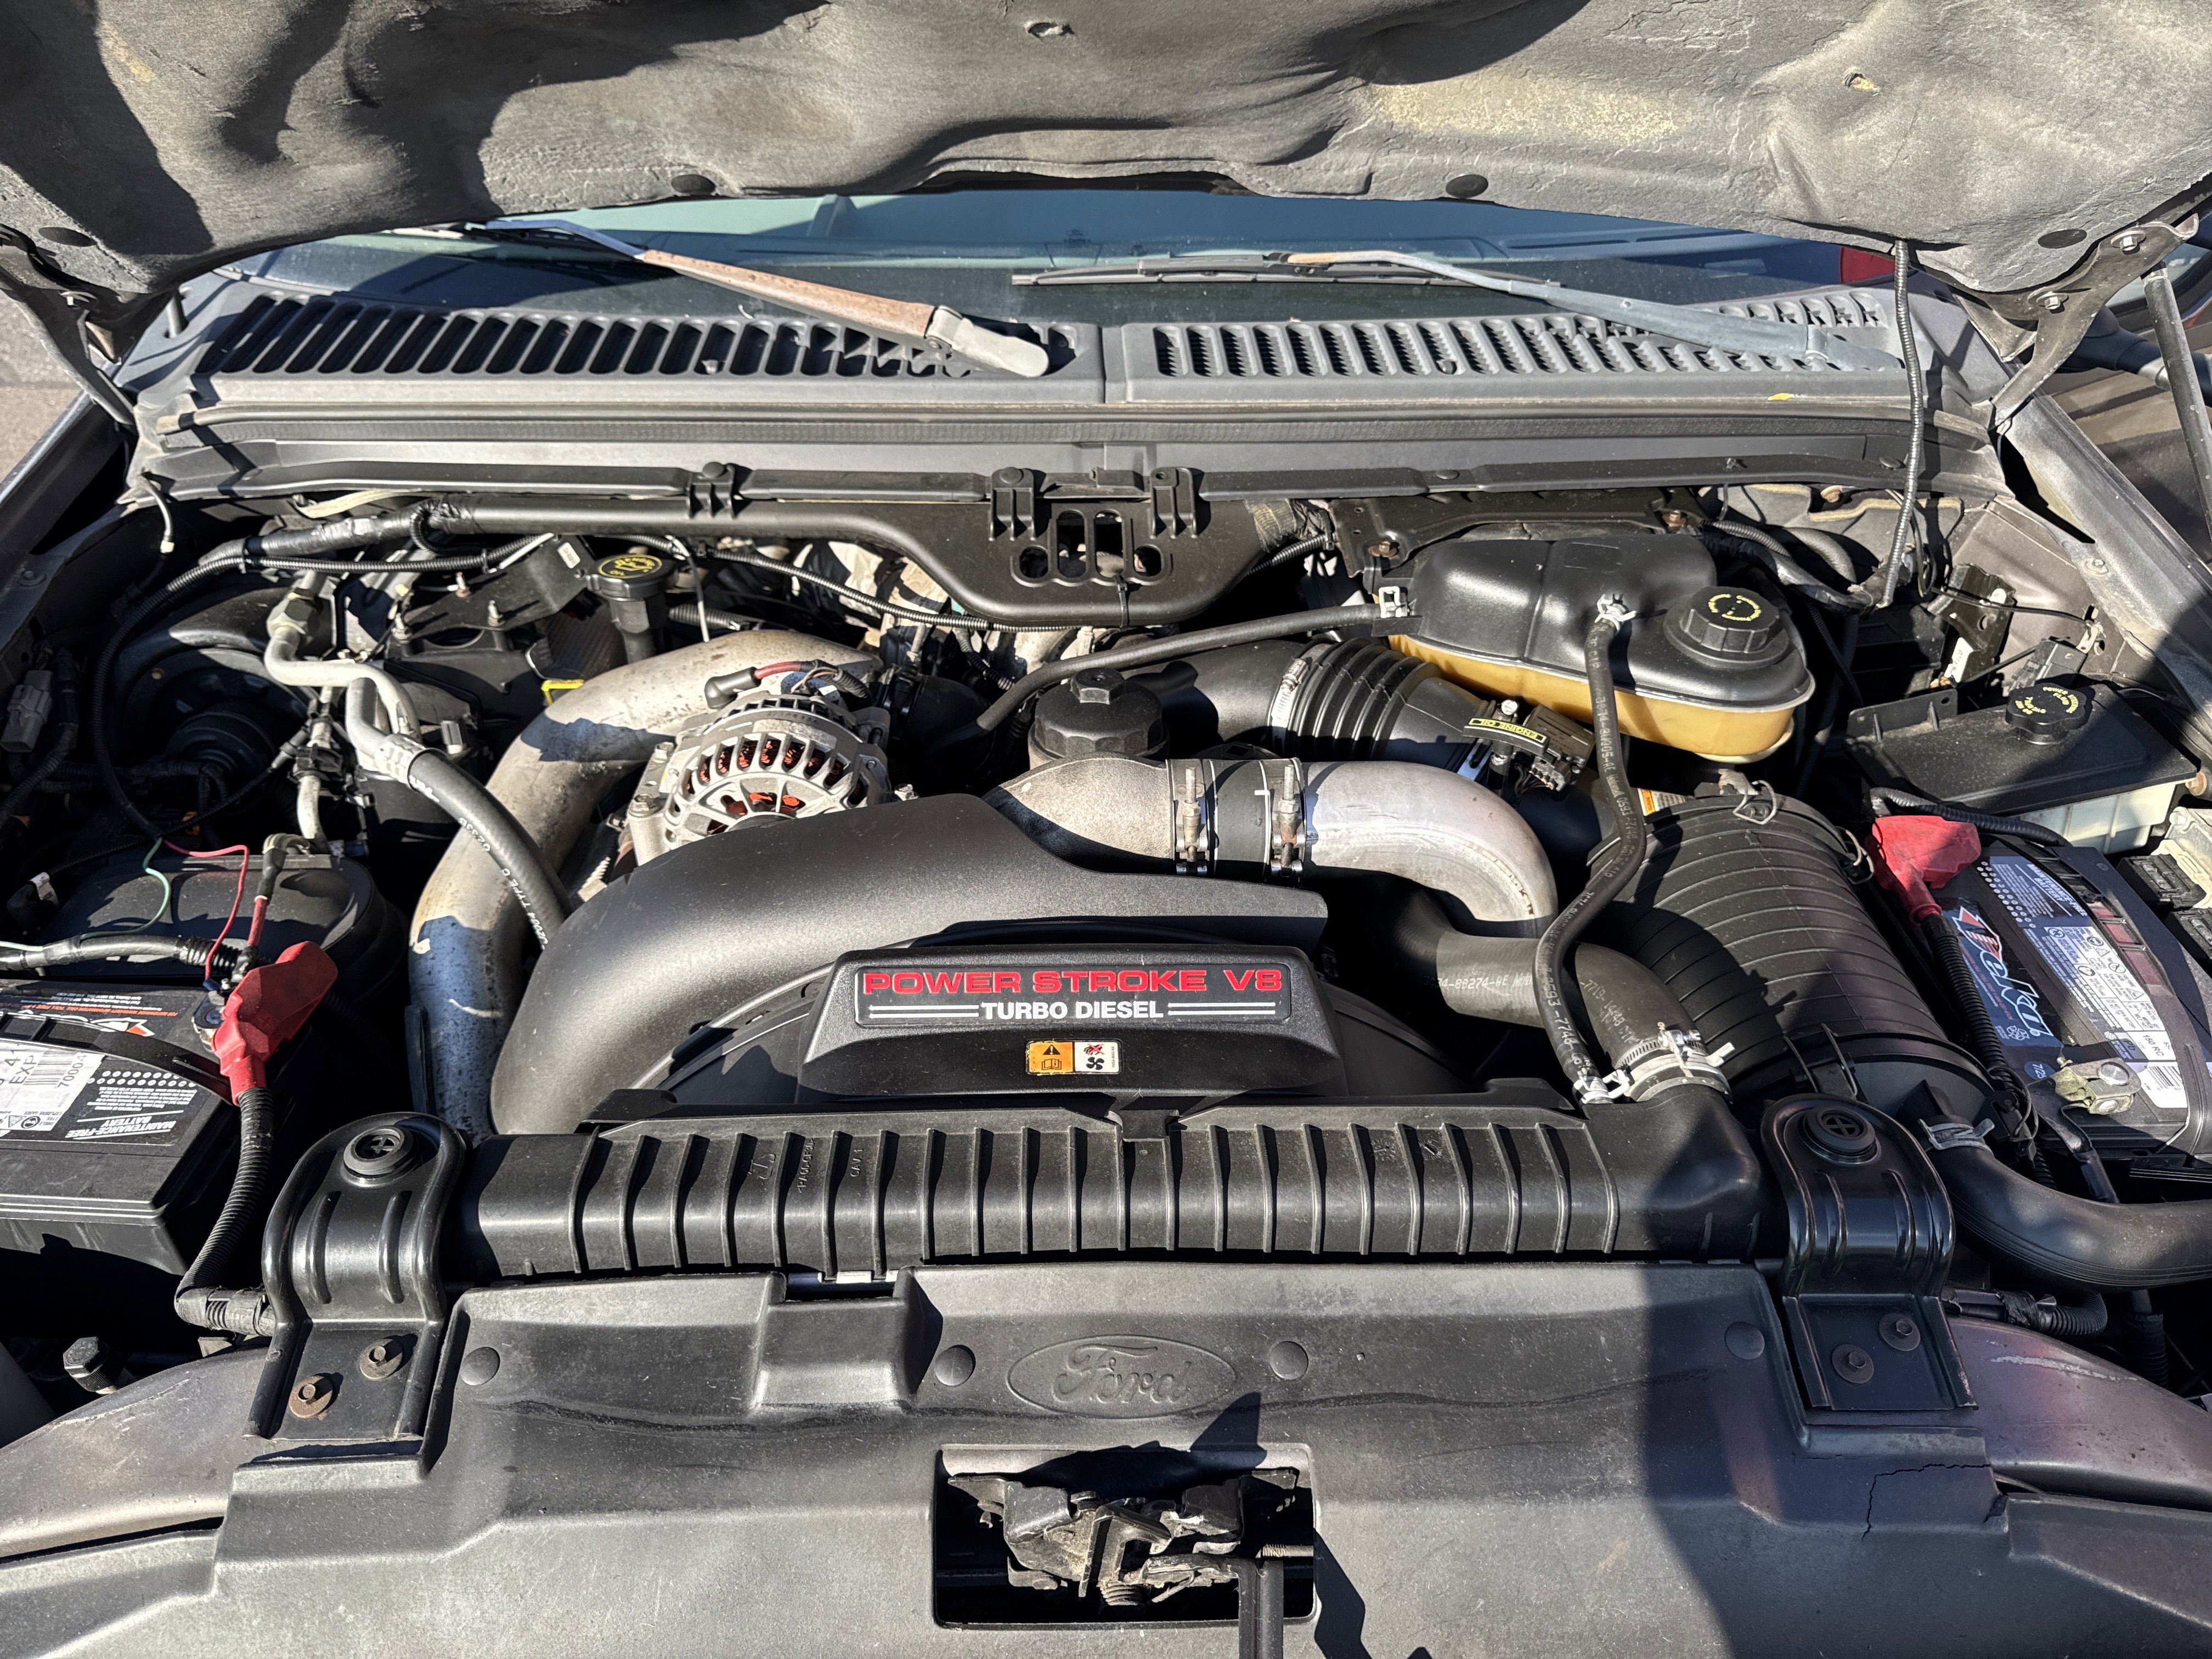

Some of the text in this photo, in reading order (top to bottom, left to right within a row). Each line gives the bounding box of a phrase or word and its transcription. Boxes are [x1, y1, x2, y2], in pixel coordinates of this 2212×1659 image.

[1498, 722, 1537, 738] ENGINE
[2027, 864, 2088, 917] MAINTENANCE-FREE
[2034, 876, 2064, 903] BATTERY
[863, 970, 1282, 995] POWER STROKE V8
[1952, 906, 2053, 1037] Deka
[981, 1001, 1163, 1020] TURBO DIESEL
[2142, 1034, 2156, 1046] 150
[2151, 1045, 2165, 1057] RC
[9, 1055, 37, 1084] EXP
[2032, 1063, 2045, 1080] 7/25
[65, 1120, 177, 1138] MAINTENANCE-FREE
[100, 1116, 152, 1127] BATTERY
[1053, 1344, 1190, 1403] Ford
